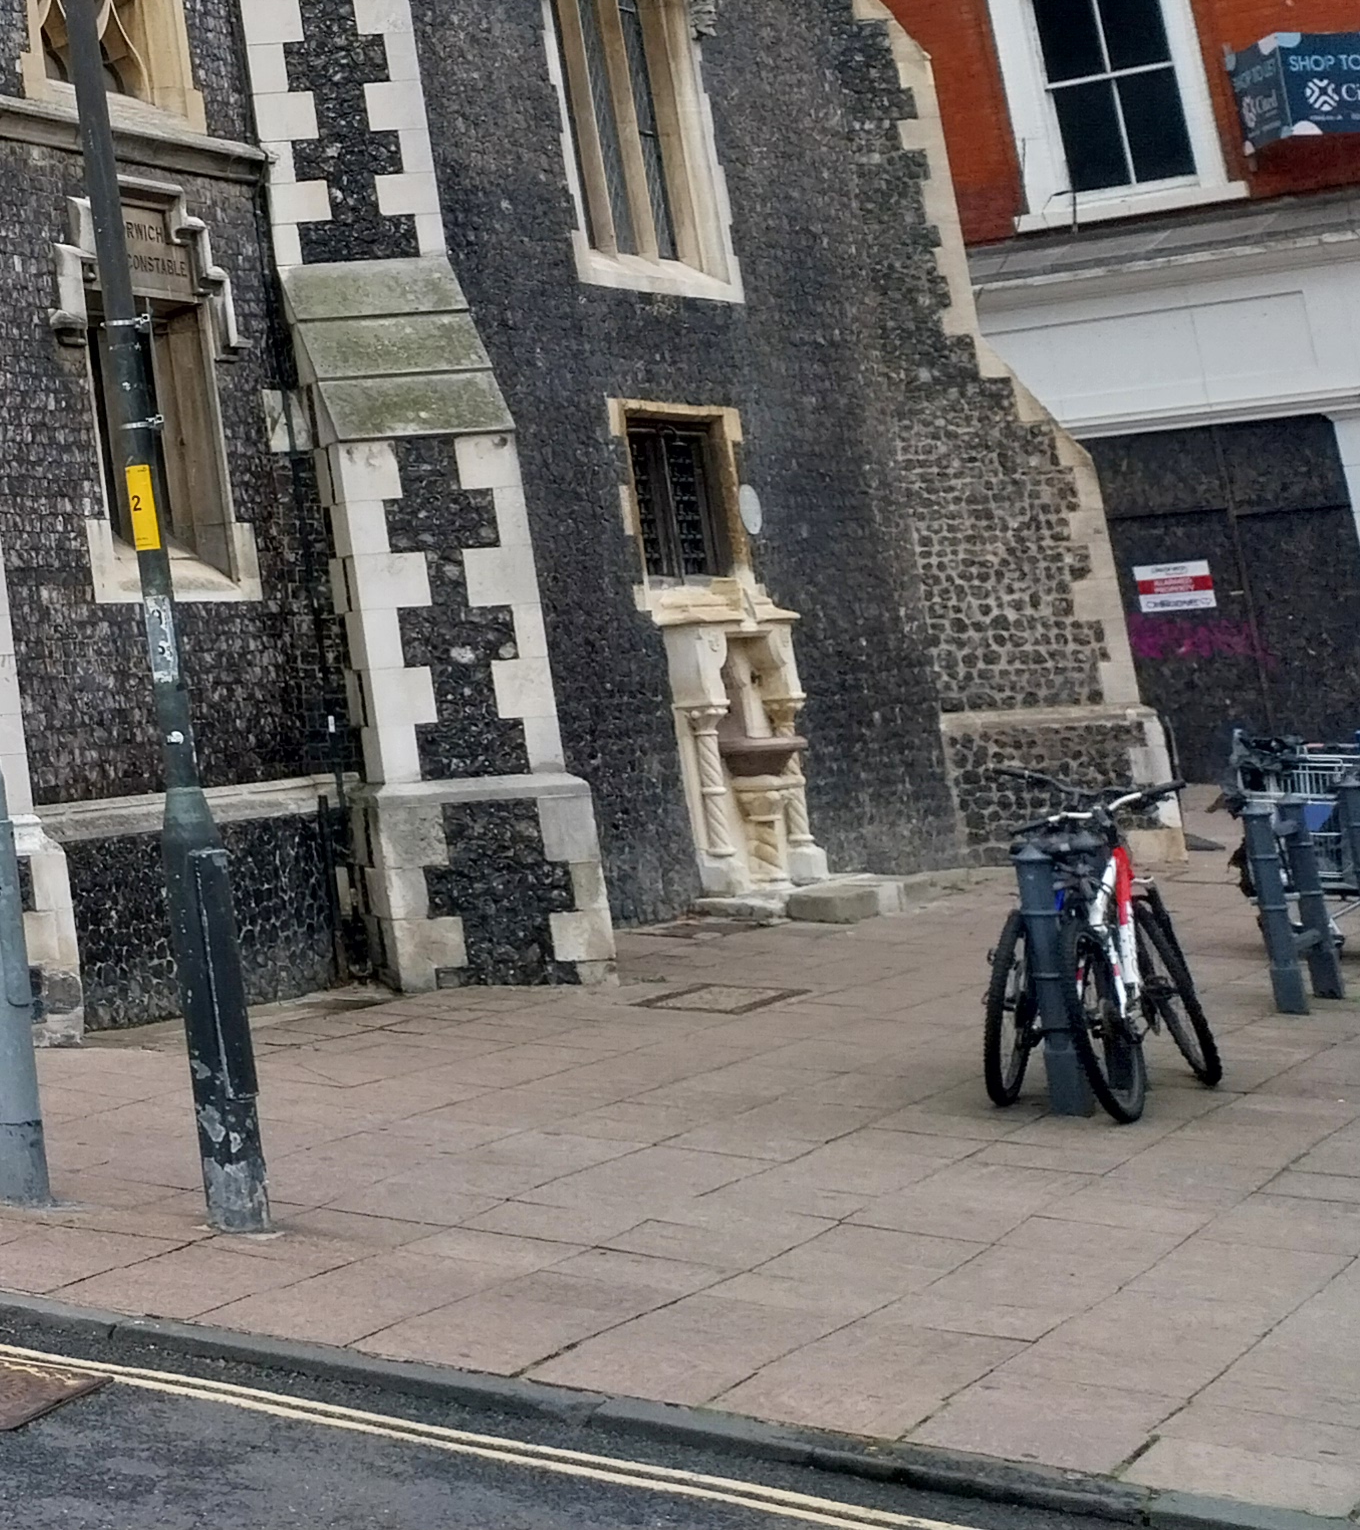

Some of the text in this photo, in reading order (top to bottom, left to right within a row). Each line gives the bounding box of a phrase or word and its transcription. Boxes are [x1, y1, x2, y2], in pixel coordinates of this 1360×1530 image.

[1289, 55, 1335, 71] SHOP
[126, 222, 165, 243] RWICH
[132, 495, 142, 511] 2
